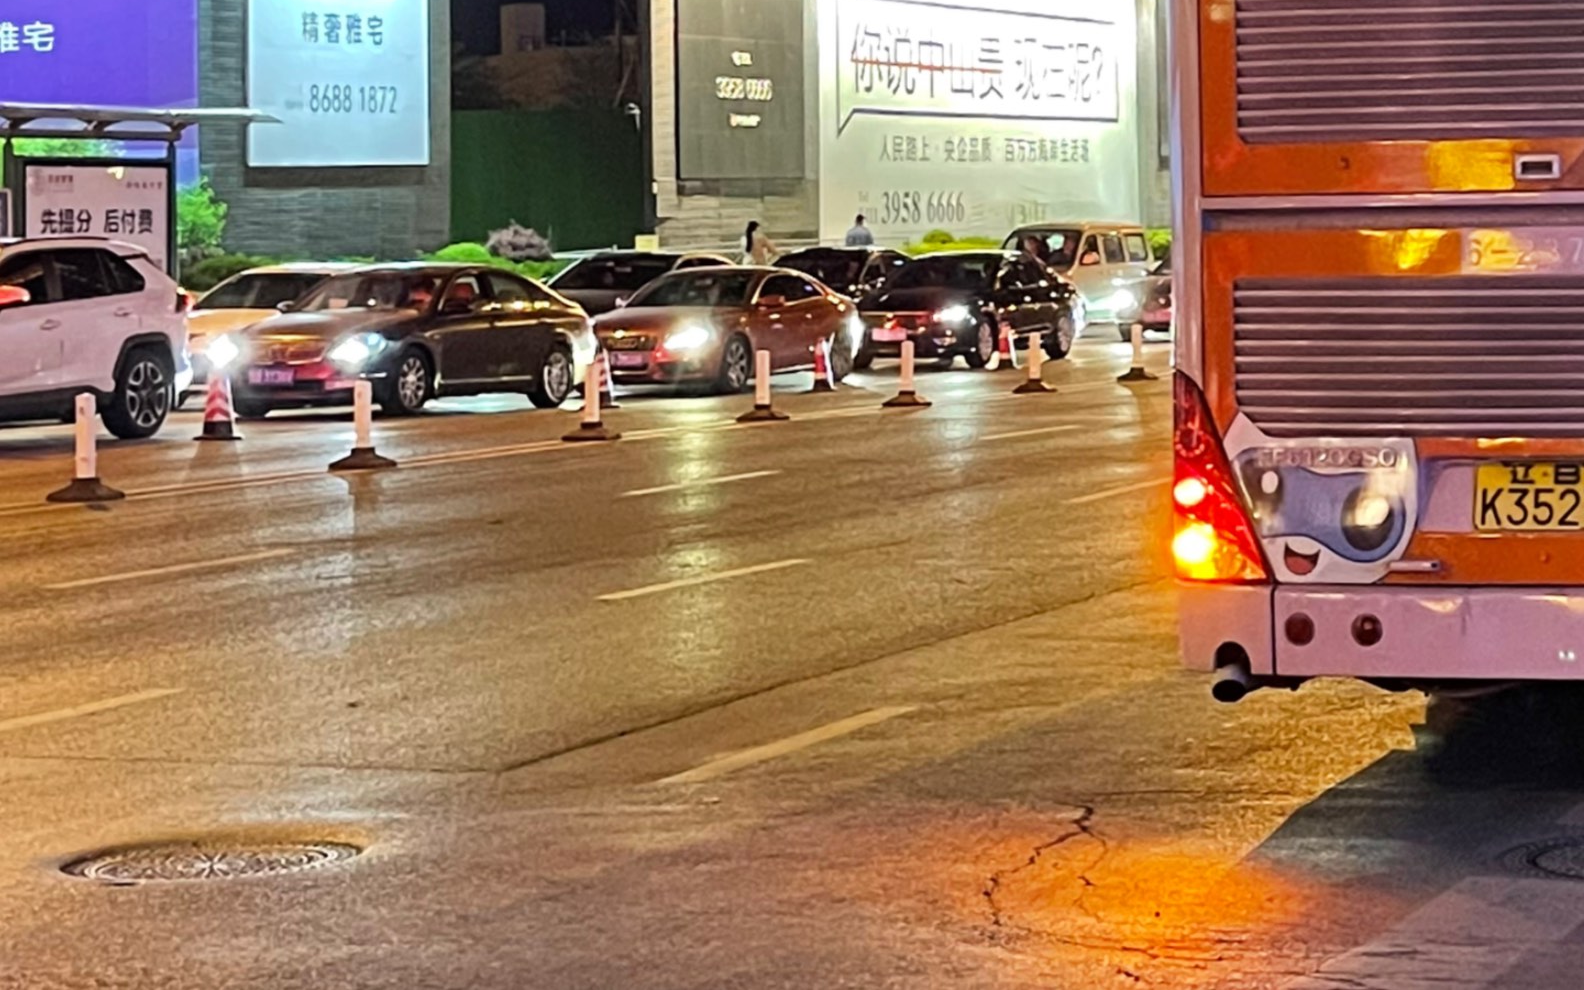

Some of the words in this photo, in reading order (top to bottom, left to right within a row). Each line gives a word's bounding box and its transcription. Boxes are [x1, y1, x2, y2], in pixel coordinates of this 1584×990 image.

[302, 11, 383, 46] 精奢雅宅
[310, 83, 352, 113] 8688
[359, 85, 397, 113] 1872
[103, 209, 153, 234] 后付费
[881, 190, 921, 225] 3958
[926, 190, 966, 223] 6666
